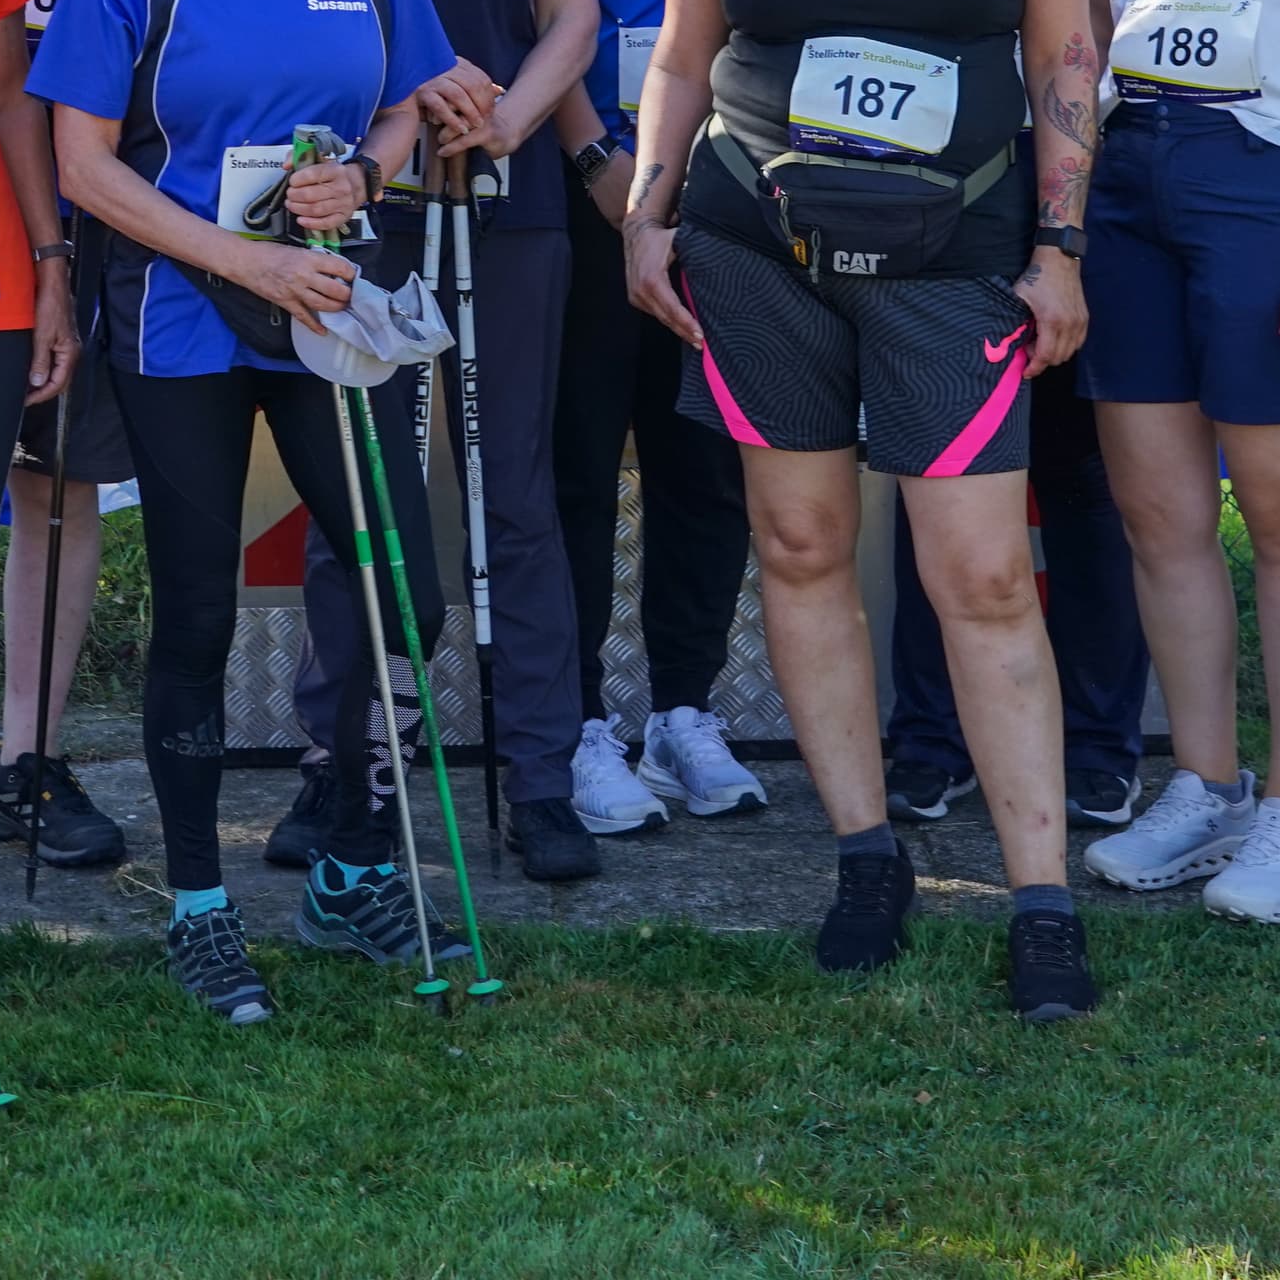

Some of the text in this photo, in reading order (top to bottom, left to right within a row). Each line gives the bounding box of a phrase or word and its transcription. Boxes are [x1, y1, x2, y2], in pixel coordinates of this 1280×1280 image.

[626, 39, 656, 48] Stellic
[1148, 26, 1218, 67] 188
[808, 49, 927, 71] Stellichter Straßenlauf
[834, 75, 916, 121] 187
[231, 158, 284, 169] Stellichte
[833, 251, 881, 275] CAT
